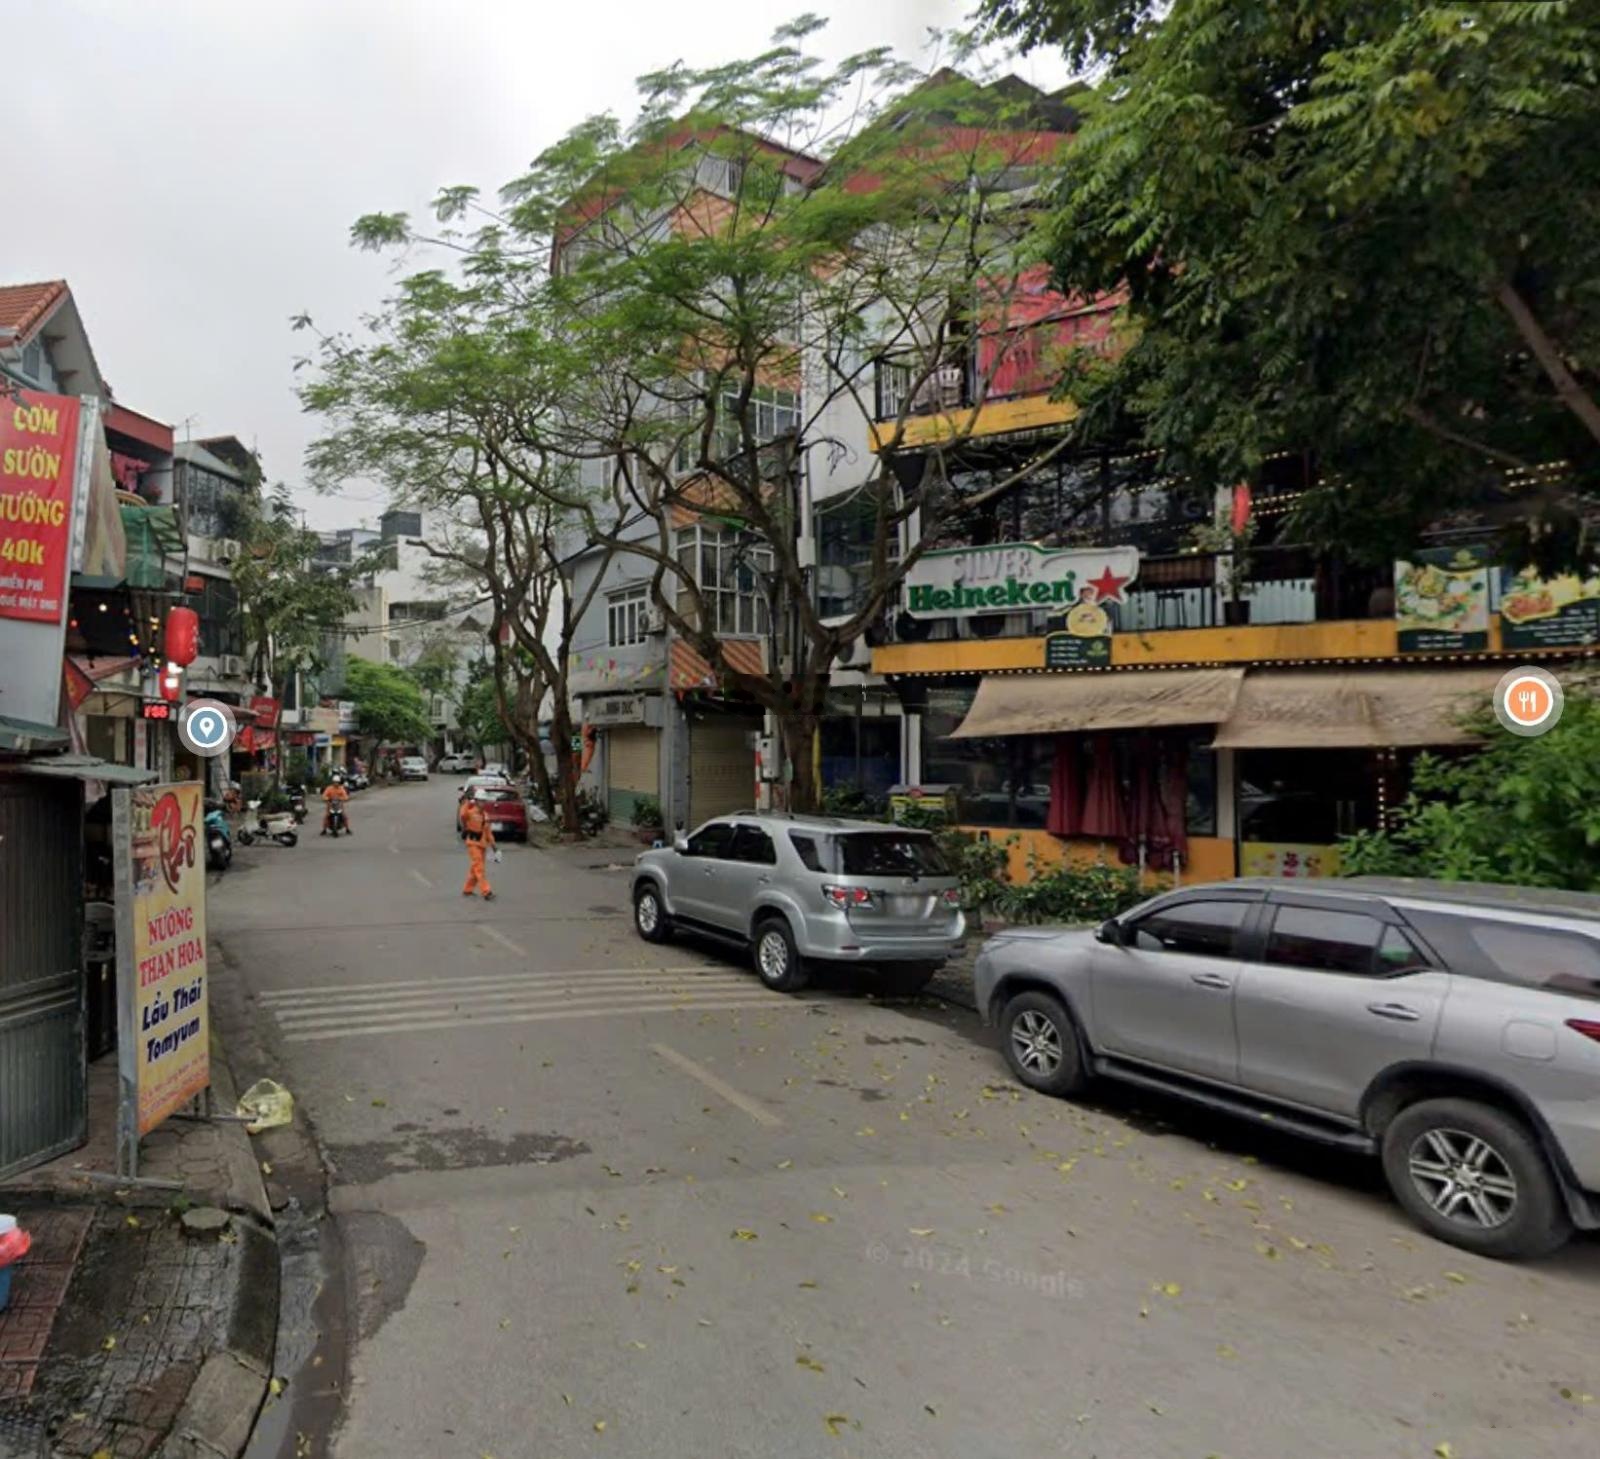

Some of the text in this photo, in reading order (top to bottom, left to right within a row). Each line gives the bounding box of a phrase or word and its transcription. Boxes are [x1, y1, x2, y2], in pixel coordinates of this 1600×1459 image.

[13, 402, 58, 435] CƠM
[3, 445, 61, 479] SƯỜN
[952, 549, 1033, 582] SILVER
[907, 576, 1076, 612] Heineken
[139, 936, 203, 988] THAN HOA
[142, 977, 202, 1031] Lẩu Thái
[147, 1016, 200, 1063] Tomyum
